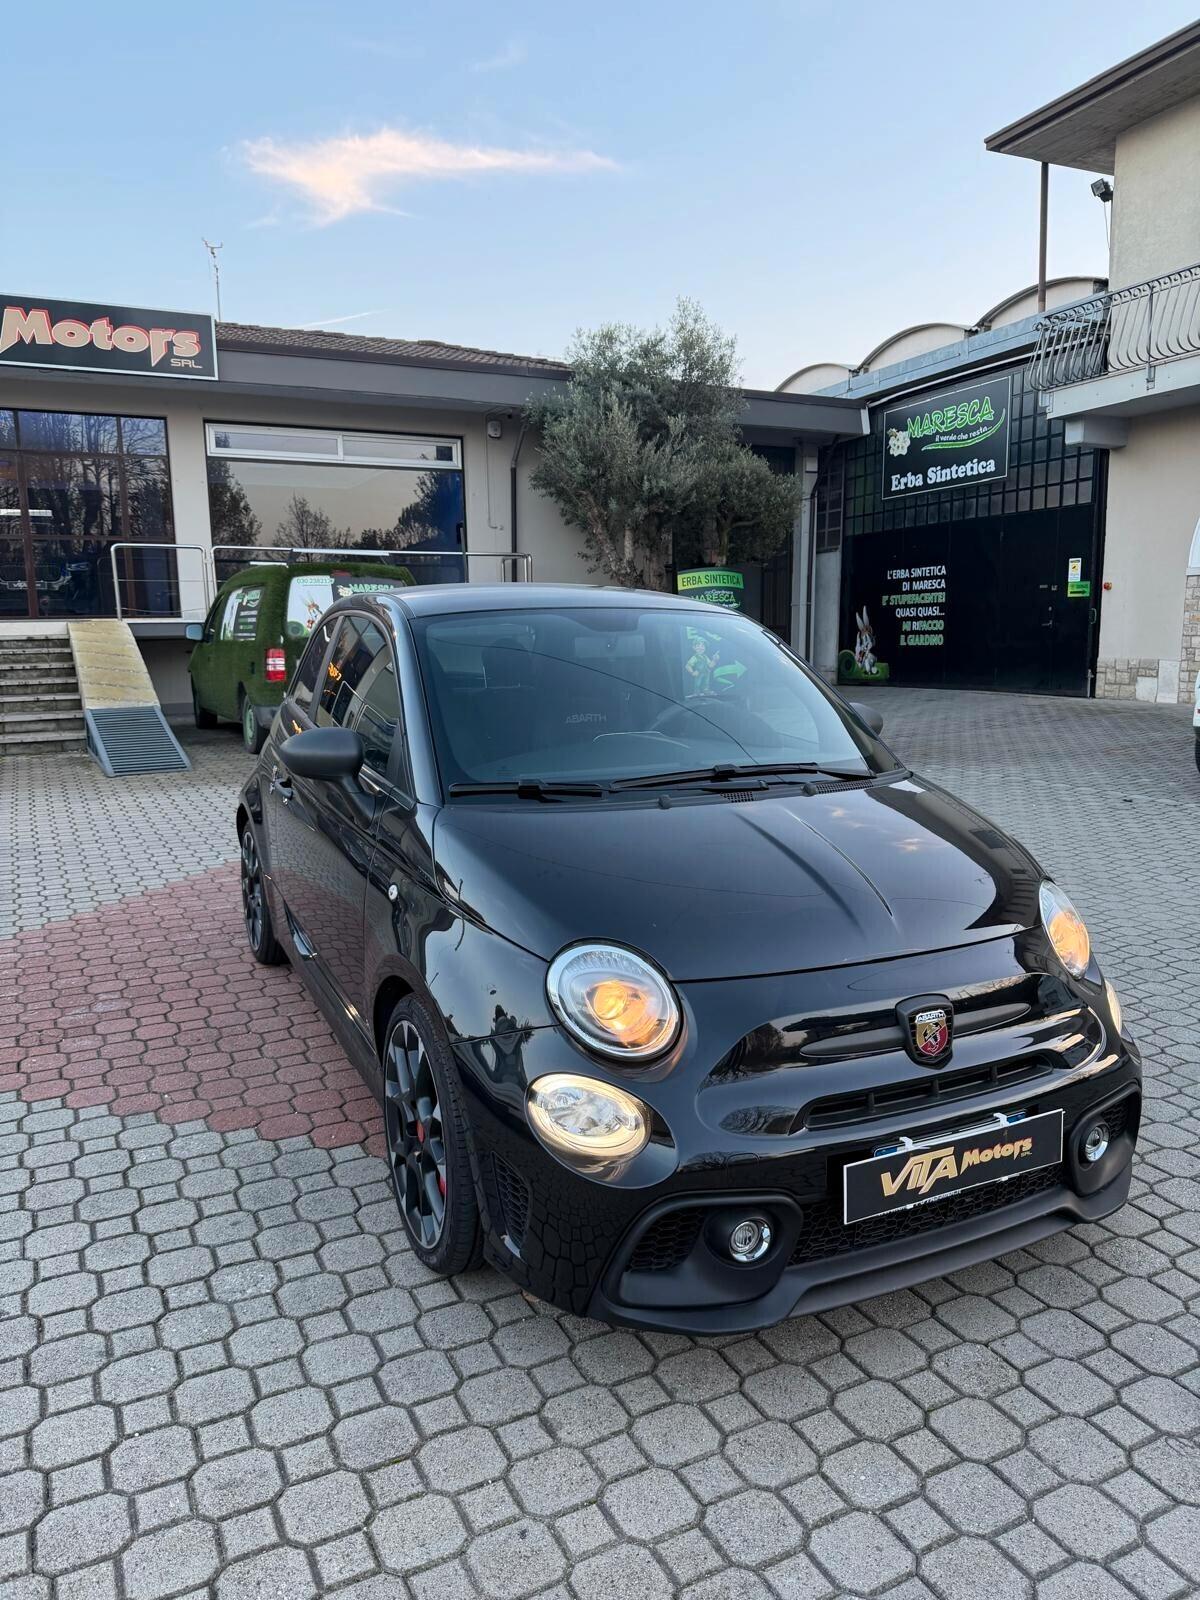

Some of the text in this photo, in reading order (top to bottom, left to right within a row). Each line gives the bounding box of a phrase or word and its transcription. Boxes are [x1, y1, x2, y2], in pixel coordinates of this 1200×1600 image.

[0, 306, 201, 367] Motors
[171, 358, 202, 369] SRL
[906, 396, 995, 439] MARESCA
[890, 458, 996, 492] Erba Sintetica
[887, 565, 947, 580] L'ERBA SINTETICA
[681, 574, 741, 587] ERBA SINTETICA
[902, 579, 946, 592] DI MARESCA
[895, 607, 917, 618] QUASI
[912, 619, 945, 632] RIFACCIO
[906, 634, 944, 646] GIARDINO
[918, 1012, 944, 1022] ABARTH
[880, 1136, 1033, 1198] VITA Motors
